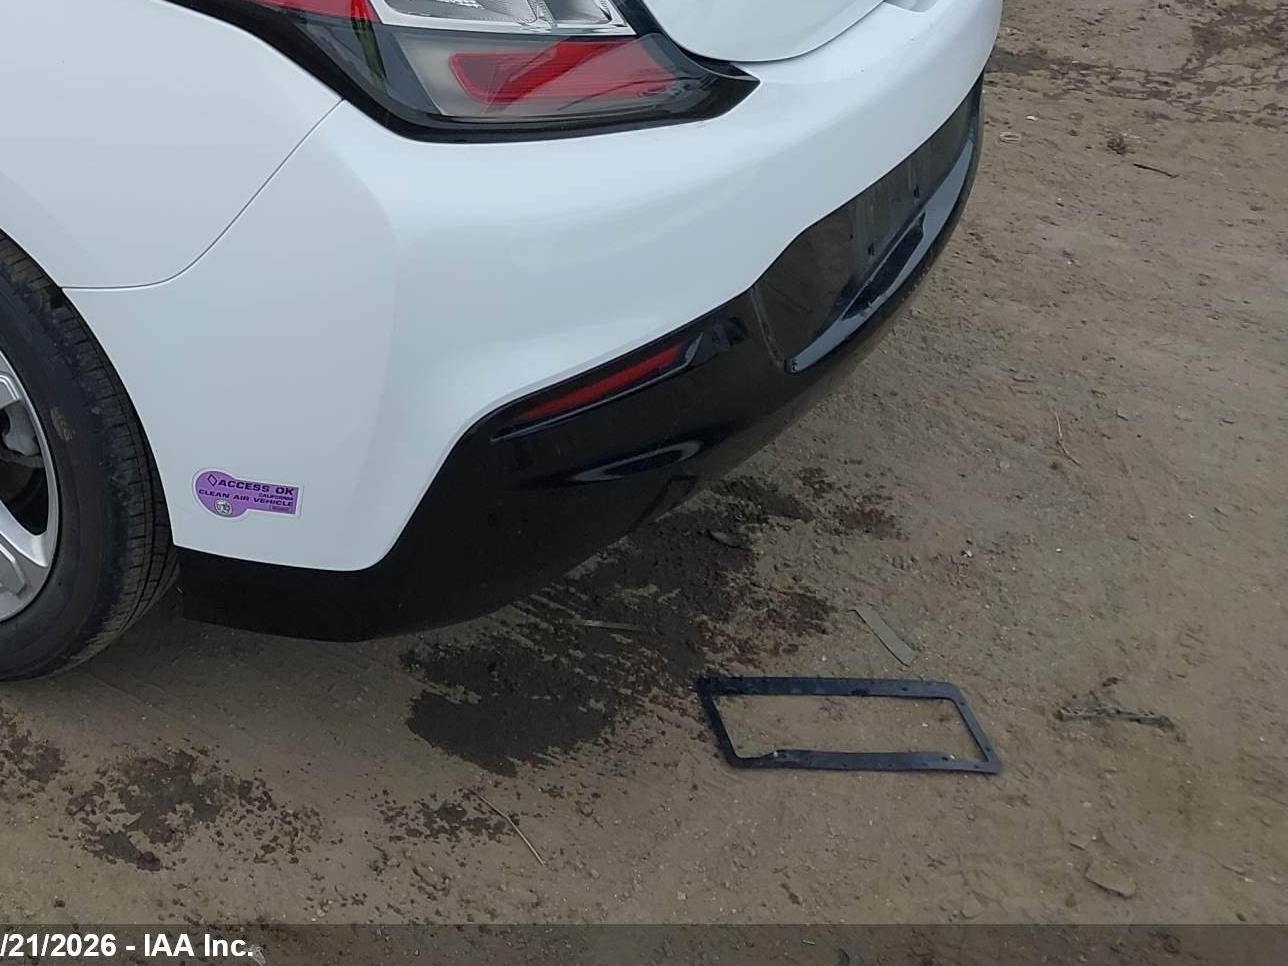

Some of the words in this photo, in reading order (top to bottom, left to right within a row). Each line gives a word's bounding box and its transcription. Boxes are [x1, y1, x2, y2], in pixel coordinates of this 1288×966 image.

[218, 479, 270, 493] ACCESS
[275, 487, 295, 496] OK
[198, 489, 230, 499] CLEAN
[253, 497, 293, 507] VEHICLE
